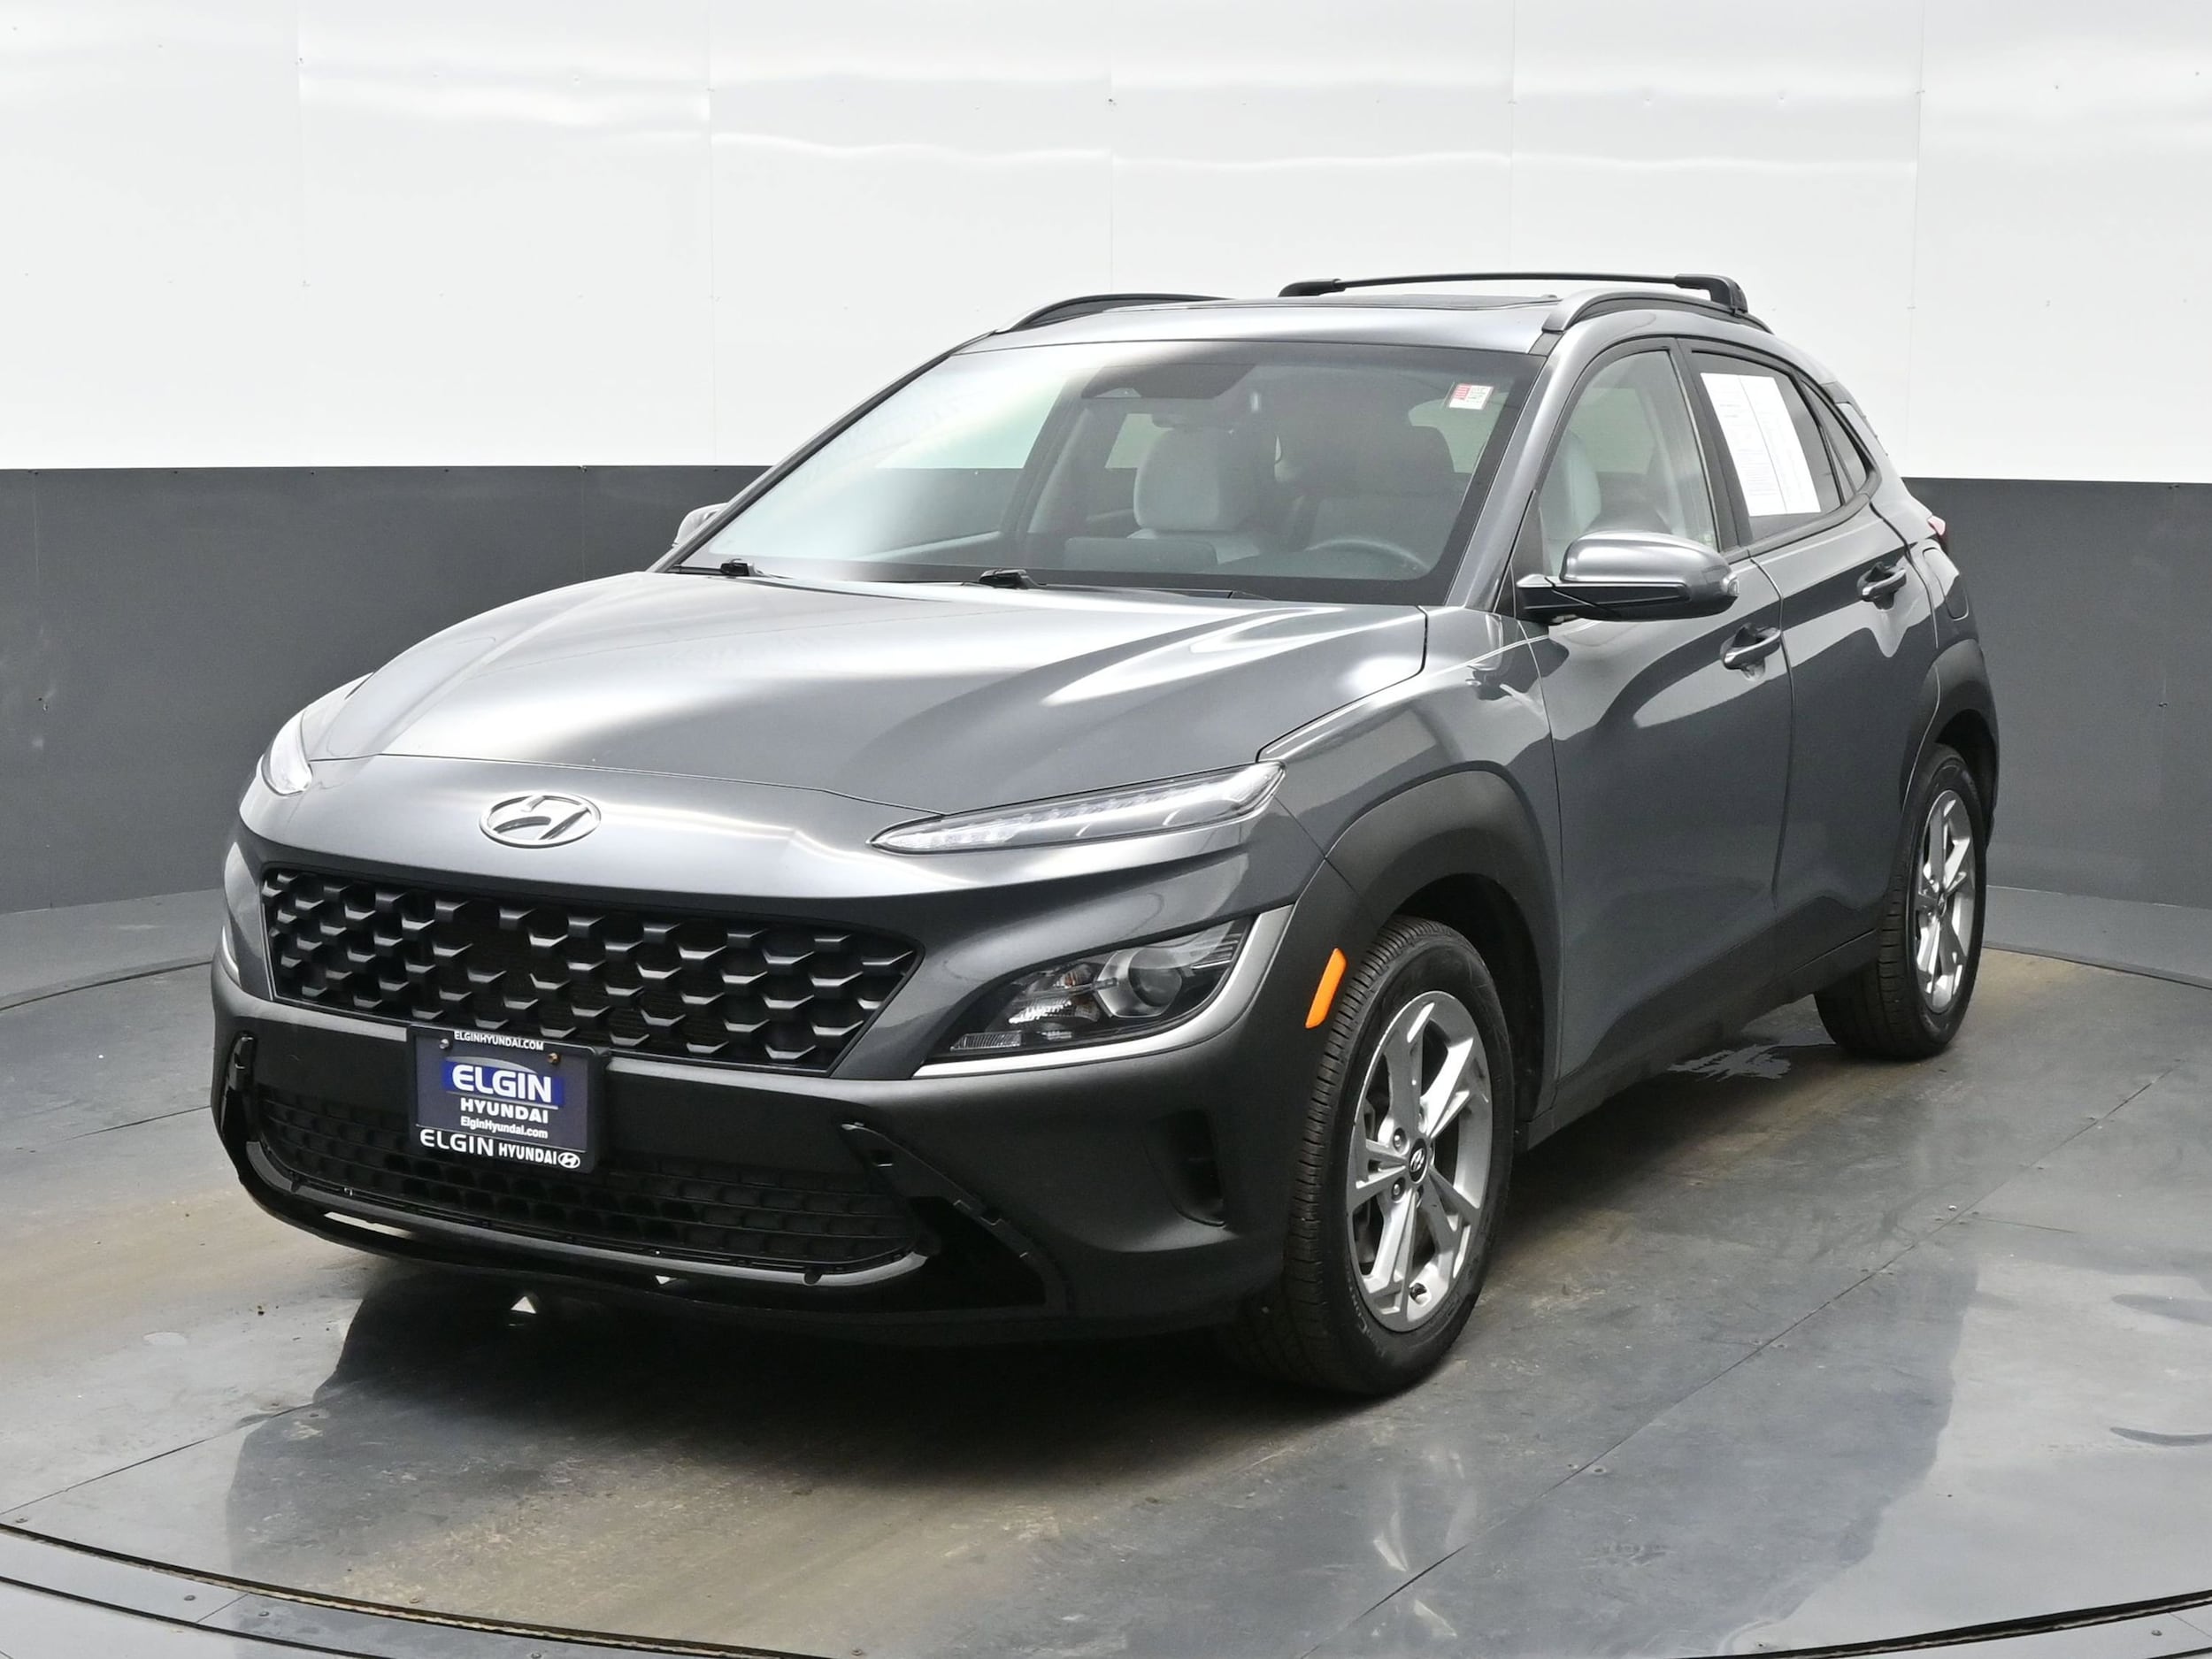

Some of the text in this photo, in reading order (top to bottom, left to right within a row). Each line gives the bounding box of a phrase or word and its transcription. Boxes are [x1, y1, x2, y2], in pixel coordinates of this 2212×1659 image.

[454, 1030, 544, 1051] ELGINHYUNDAI.COM
[452, 1064, 552, 1103] ELGIN
[460, 1098, 549, 1124] HYUNDAI
[460, 1116, 549, 1139] ElginHyundai.com
[419, 1129, 557, 1165] ELGIN HYUNDAI
